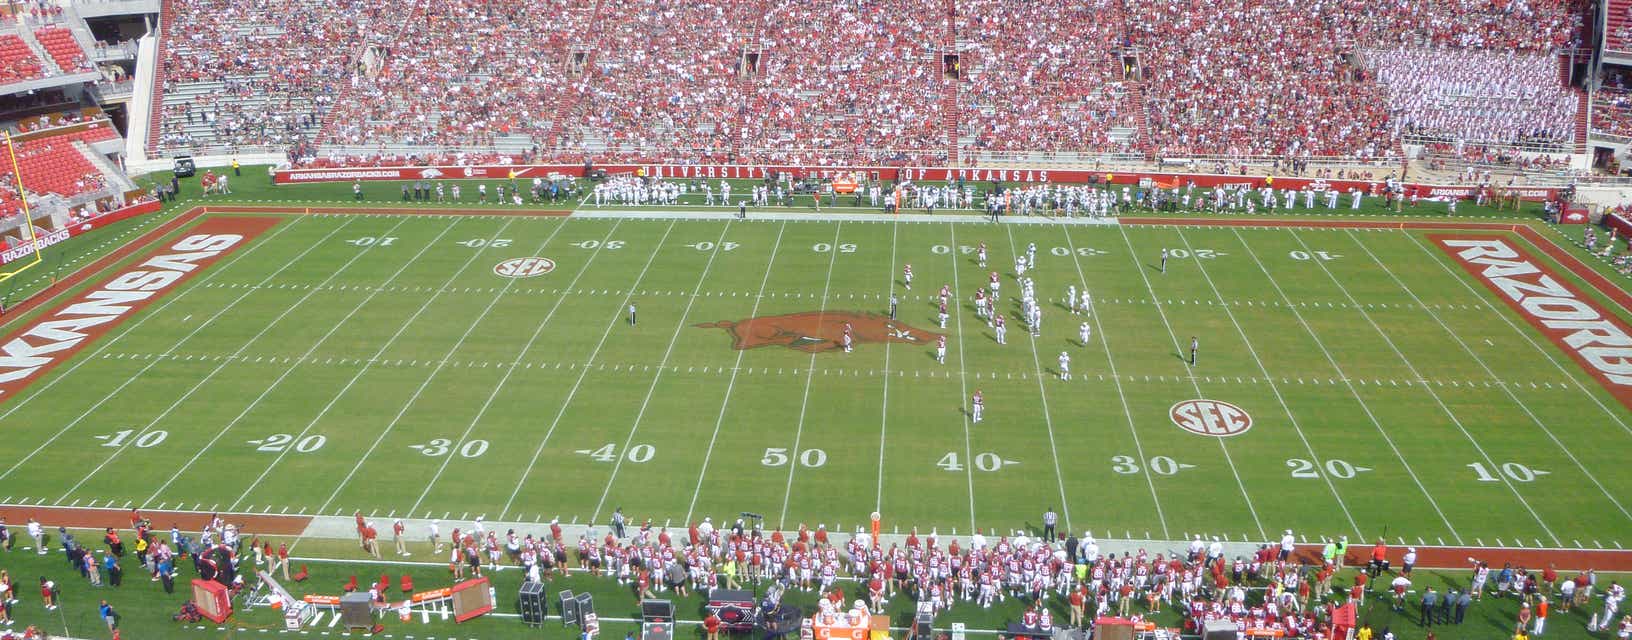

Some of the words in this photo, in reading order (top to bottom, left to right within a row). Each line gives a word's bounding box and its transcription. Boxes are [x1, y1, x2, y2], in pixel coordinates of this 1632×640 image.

[643, 167, 767, 178] UNIVERSITY
[905, 169, 926, 180] OF
[946, 169, 1047, 182] ARKANSAS
[1, 230, 71, 264] RAZORBACKS
[498, 257, 553, 277] SEC
[1442, 240, 1632, 386] RAZORB
[1175, 402, 1246, 435] SEC
[101, 429, 168, 448] 10
[256, 433, 327, 452] 20
[421, 438, 489, 458] 30
[589, 443, 656, 463] 40
[761, 447, 828, 468] 50
[936, 452, 1001, 472] 40
[1111, 455, 1178, 476] 30
[1286, 458, 1356, 479] 20
[1466, 462, 1535, 482] 10
